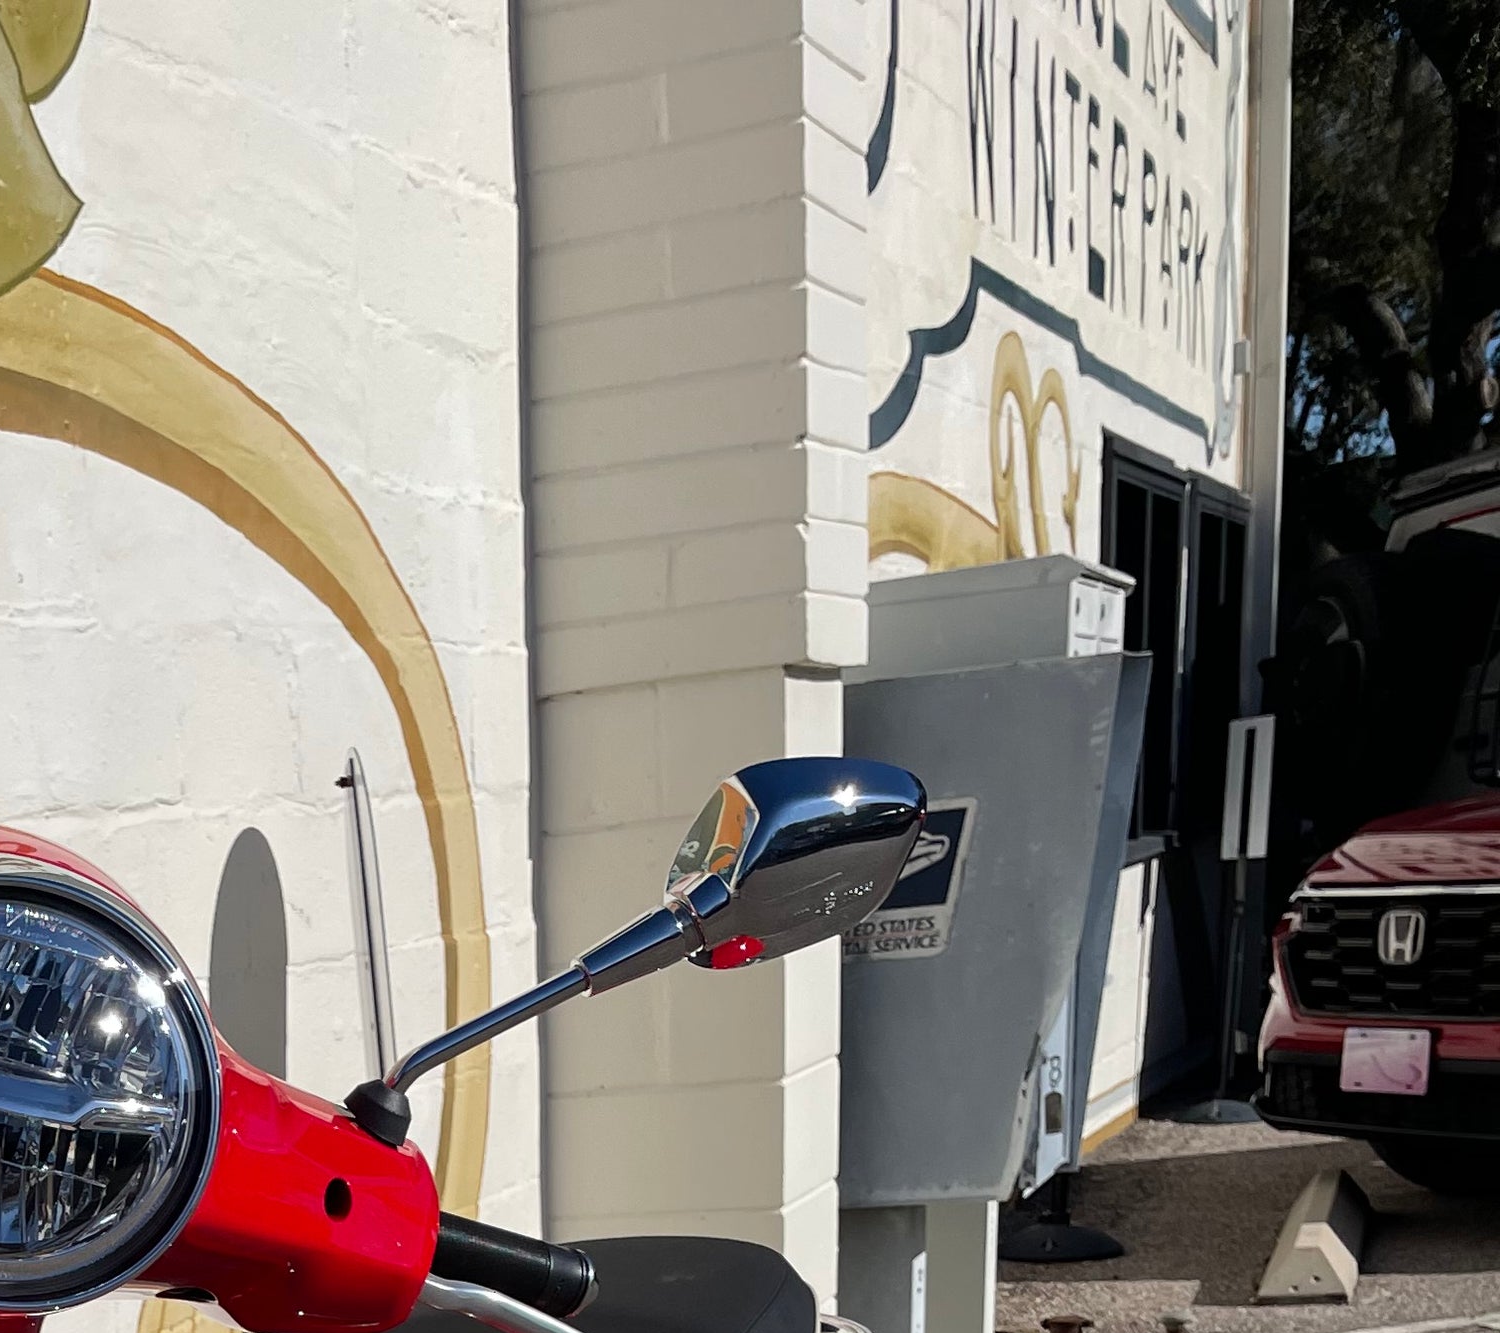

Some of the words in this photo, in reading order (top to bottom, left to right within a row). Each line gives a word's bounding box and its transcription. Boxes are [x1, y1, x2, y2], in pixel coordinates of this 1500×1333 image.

[966, 0, 1128, 319] WINTER
[1139, 147, 1208, 374] PARK
[877, 915, 936, 936] STATES
[872, 934, 941, 954] SERVICE
